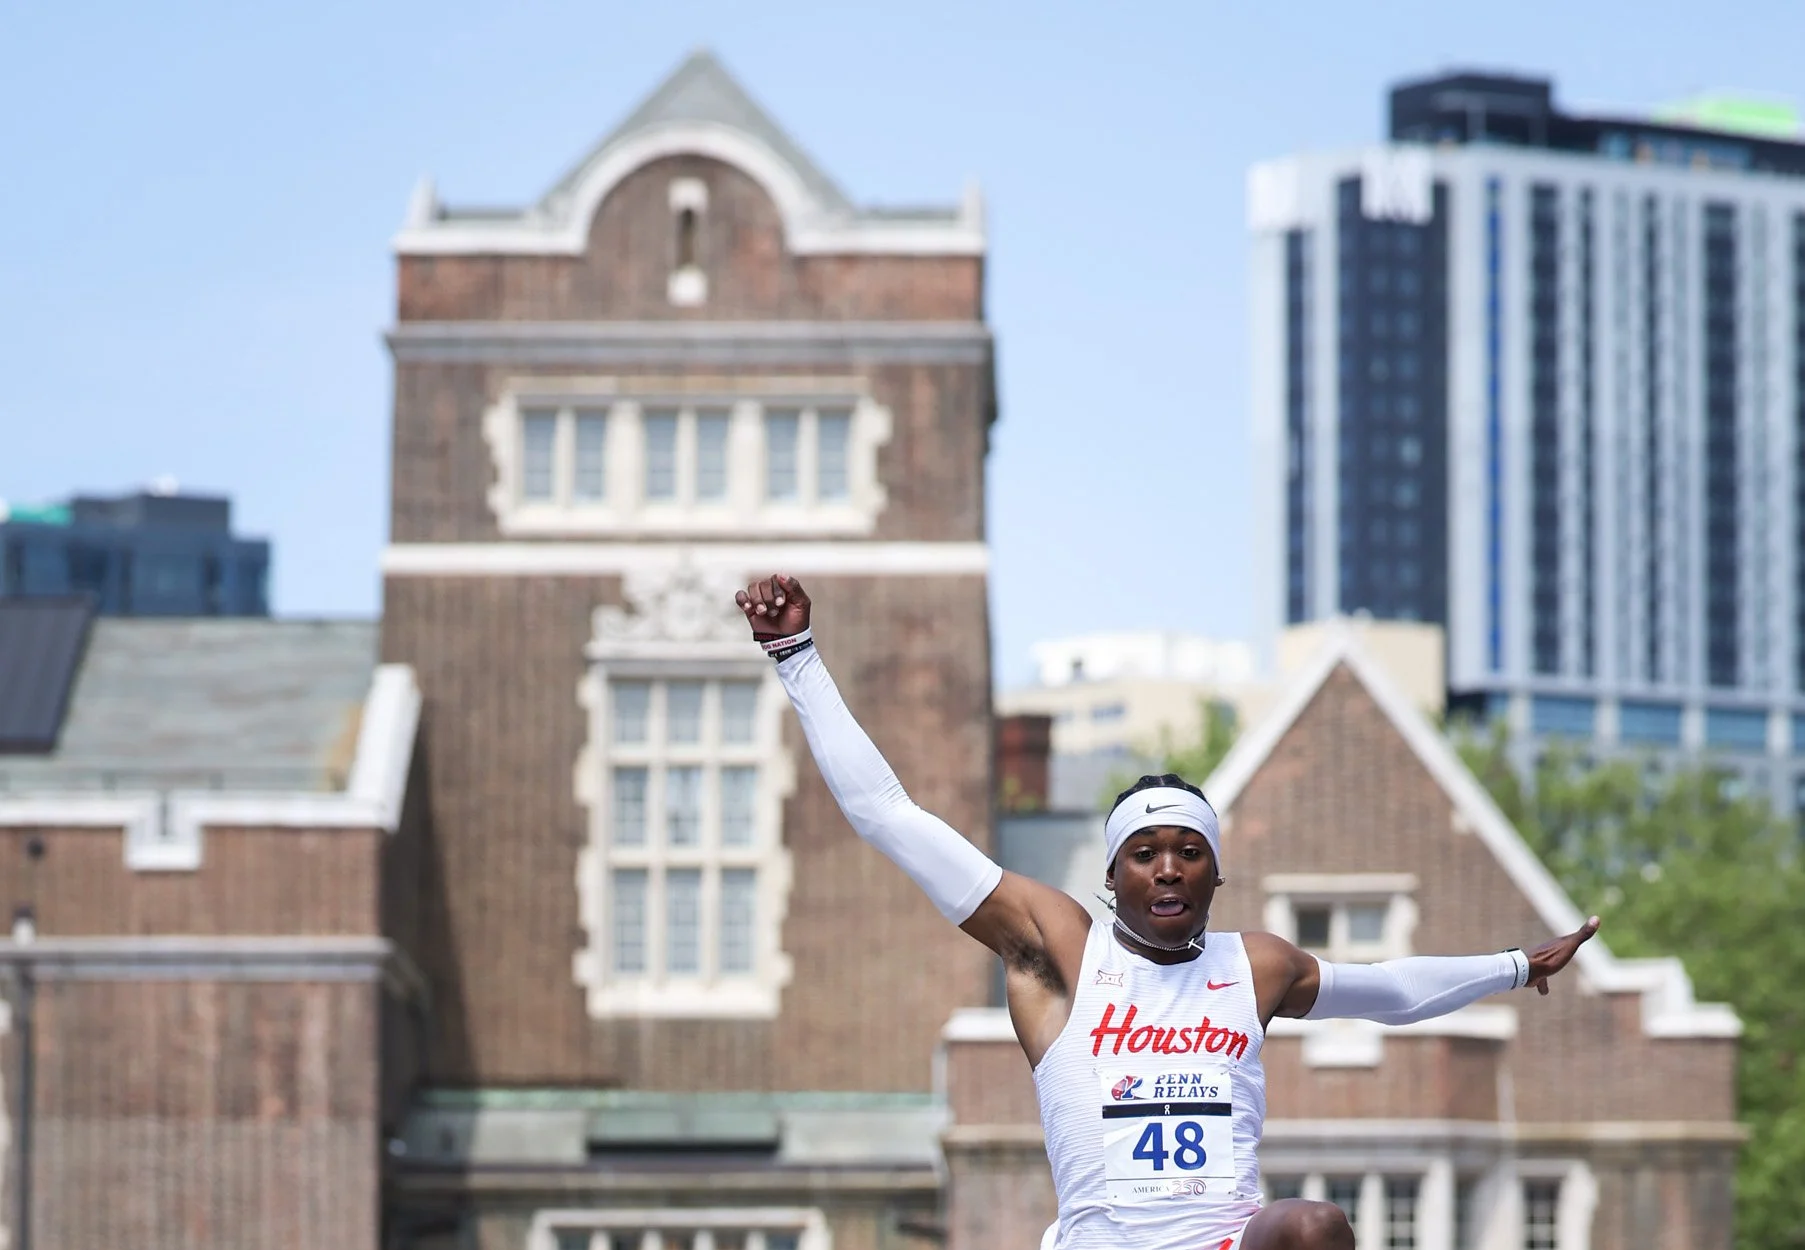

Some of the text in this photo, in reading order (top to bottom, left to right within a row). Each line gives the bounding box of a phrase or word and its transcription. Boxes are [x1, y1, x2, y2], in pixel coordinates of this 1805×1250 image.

[772, 638, 797, 648] NATION
[1090, 1003, 1249, 1060] Houston
[1155, 1073, 1202, 1085] PENN
[1153, 1086, 1219, 1098] RELAYS
[1132, 1121, 1207, 1171] 48
[1132, 1184, 1170, 1194] AMERICA
